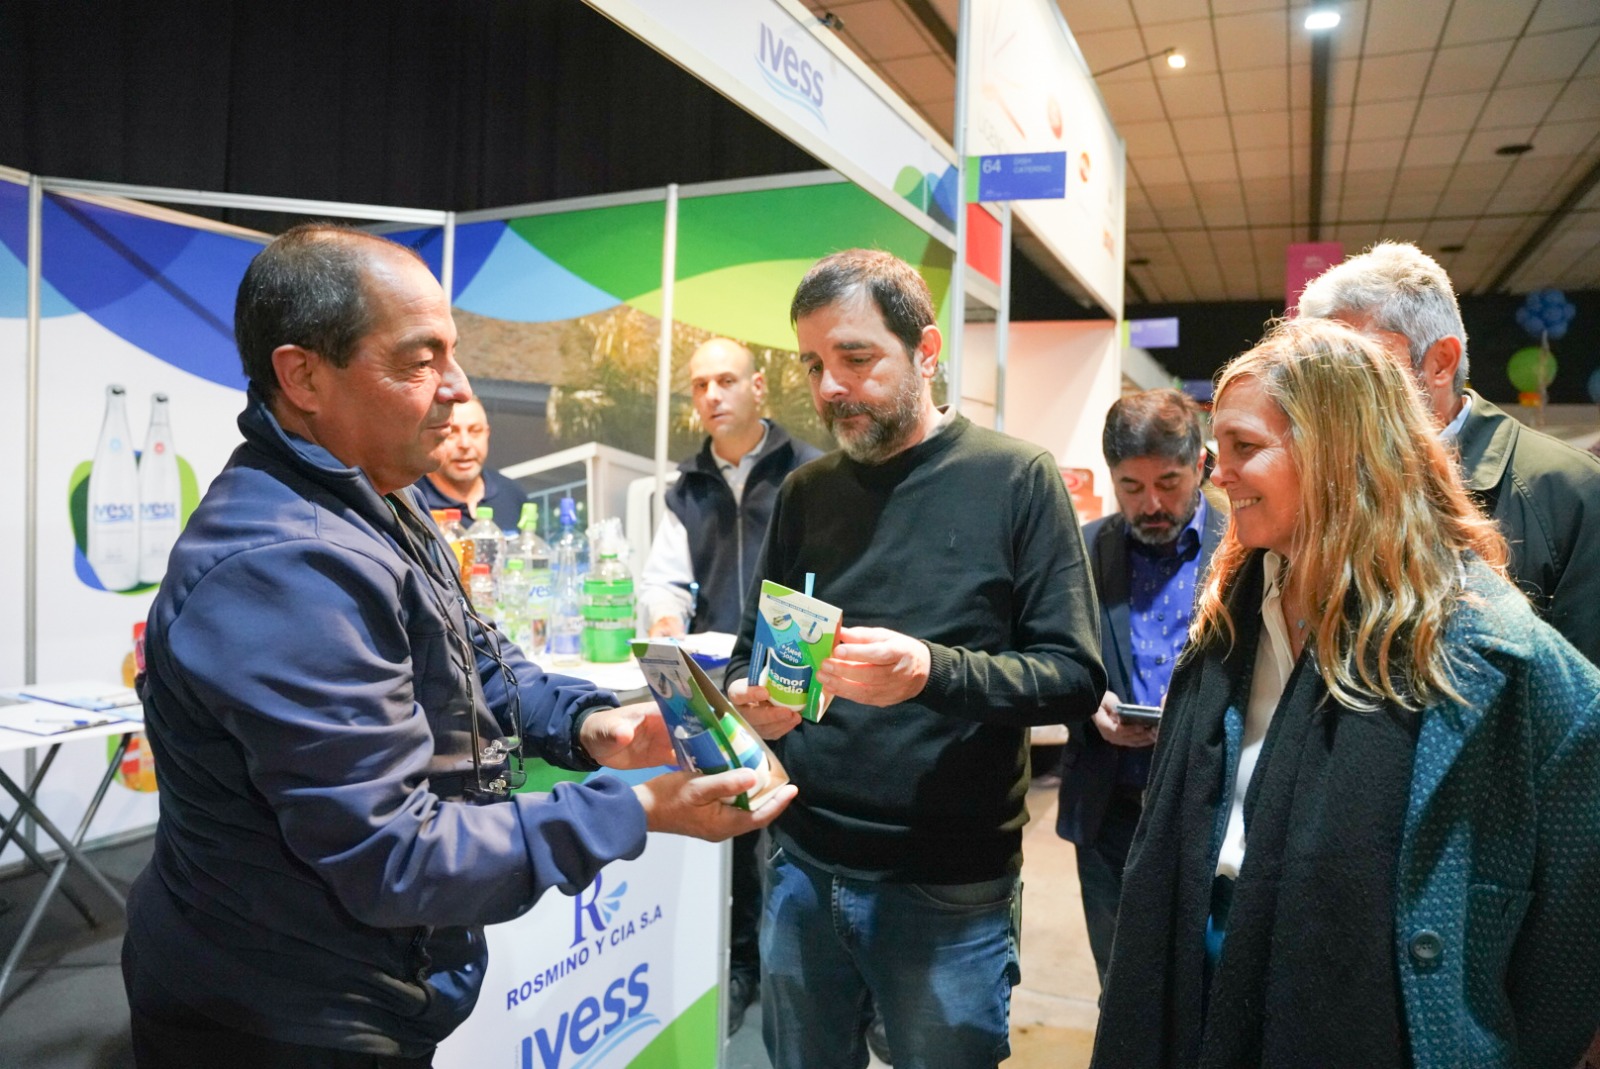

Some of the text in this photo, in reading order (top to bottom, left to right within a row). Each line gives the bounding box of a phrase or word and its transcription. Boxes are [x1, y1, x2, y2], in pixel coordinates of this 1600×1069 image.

[982, 158, 1002, 174] 64
[507, 947, 590, 1011] ROSMINO
[595, 935, 605, 955] Y
[610, 920, 636, 947] CIA
